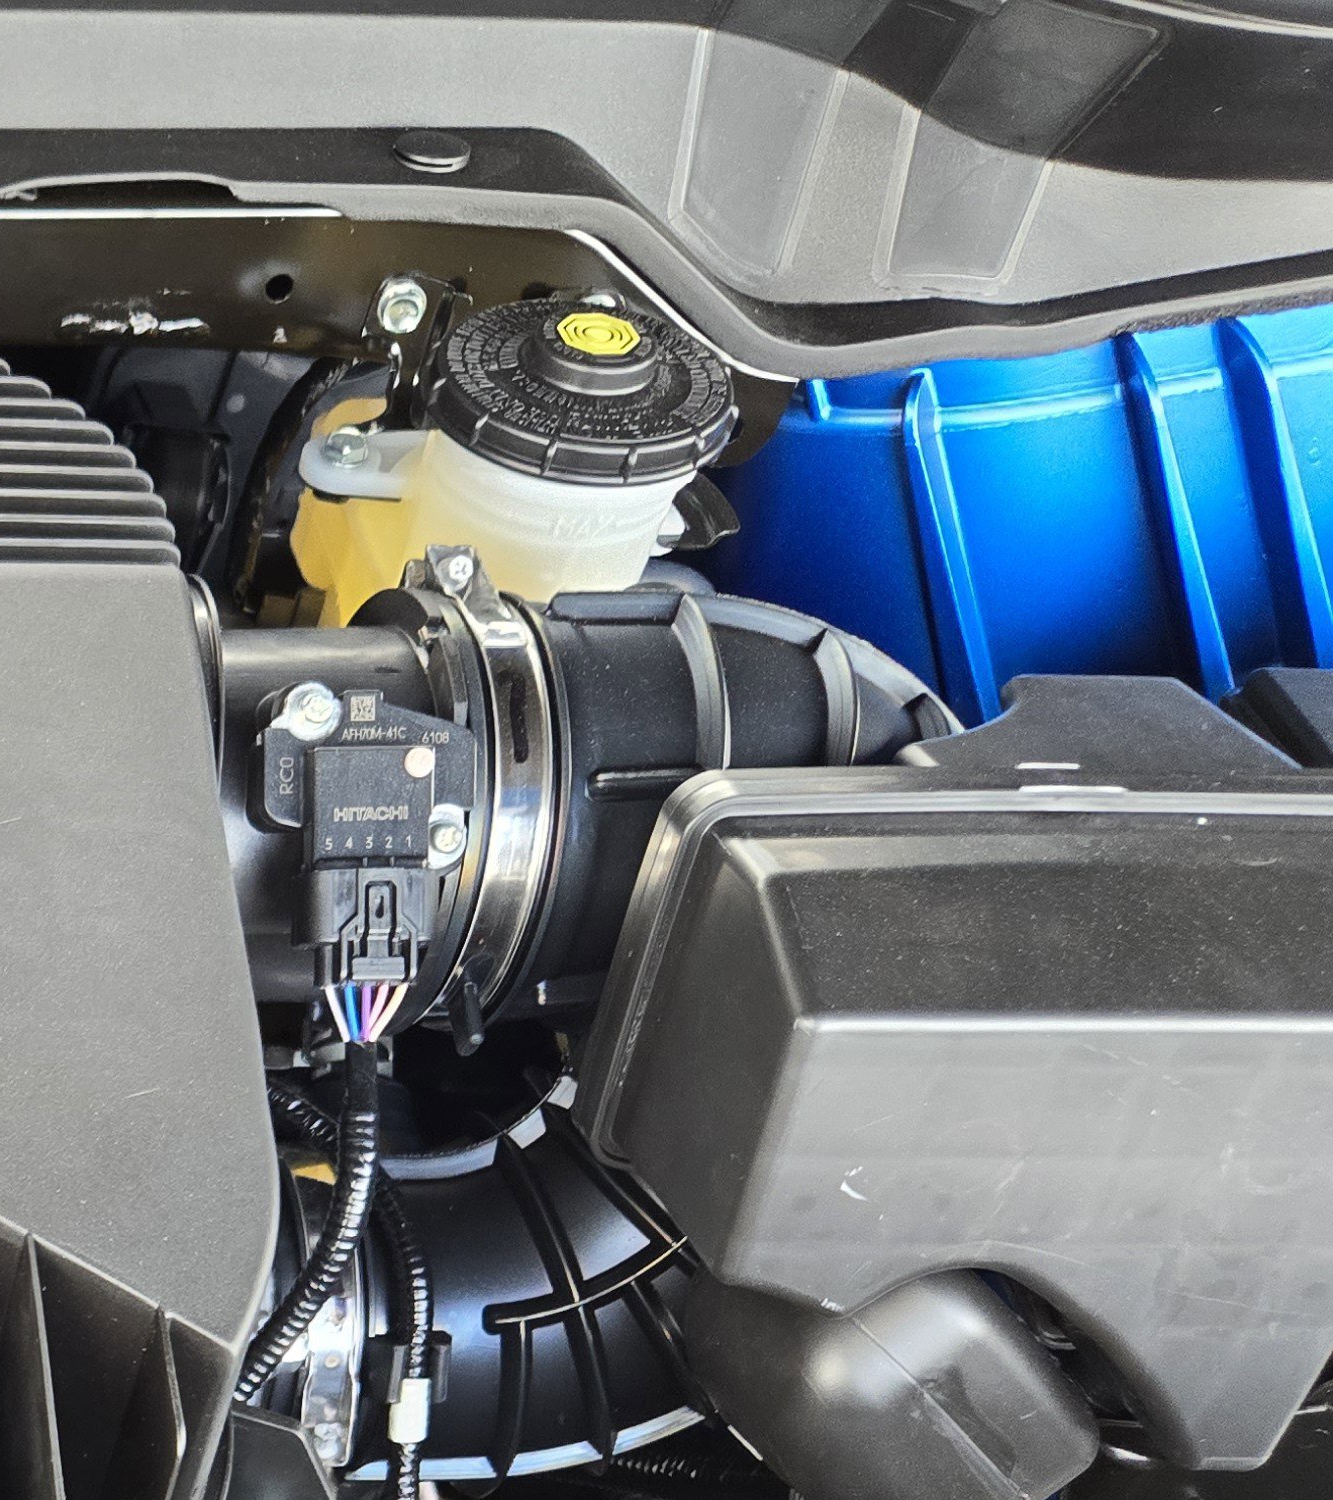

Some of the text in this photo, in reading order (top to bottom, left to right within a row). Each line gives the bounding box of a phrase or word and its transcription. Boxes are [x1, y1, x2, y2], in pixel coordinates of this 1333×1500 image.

[421, 731, 450, 744] 6108
[334, 805, 410, 822] HITACHI
[324, 835, 411, 850] 5 4 3 2 1
